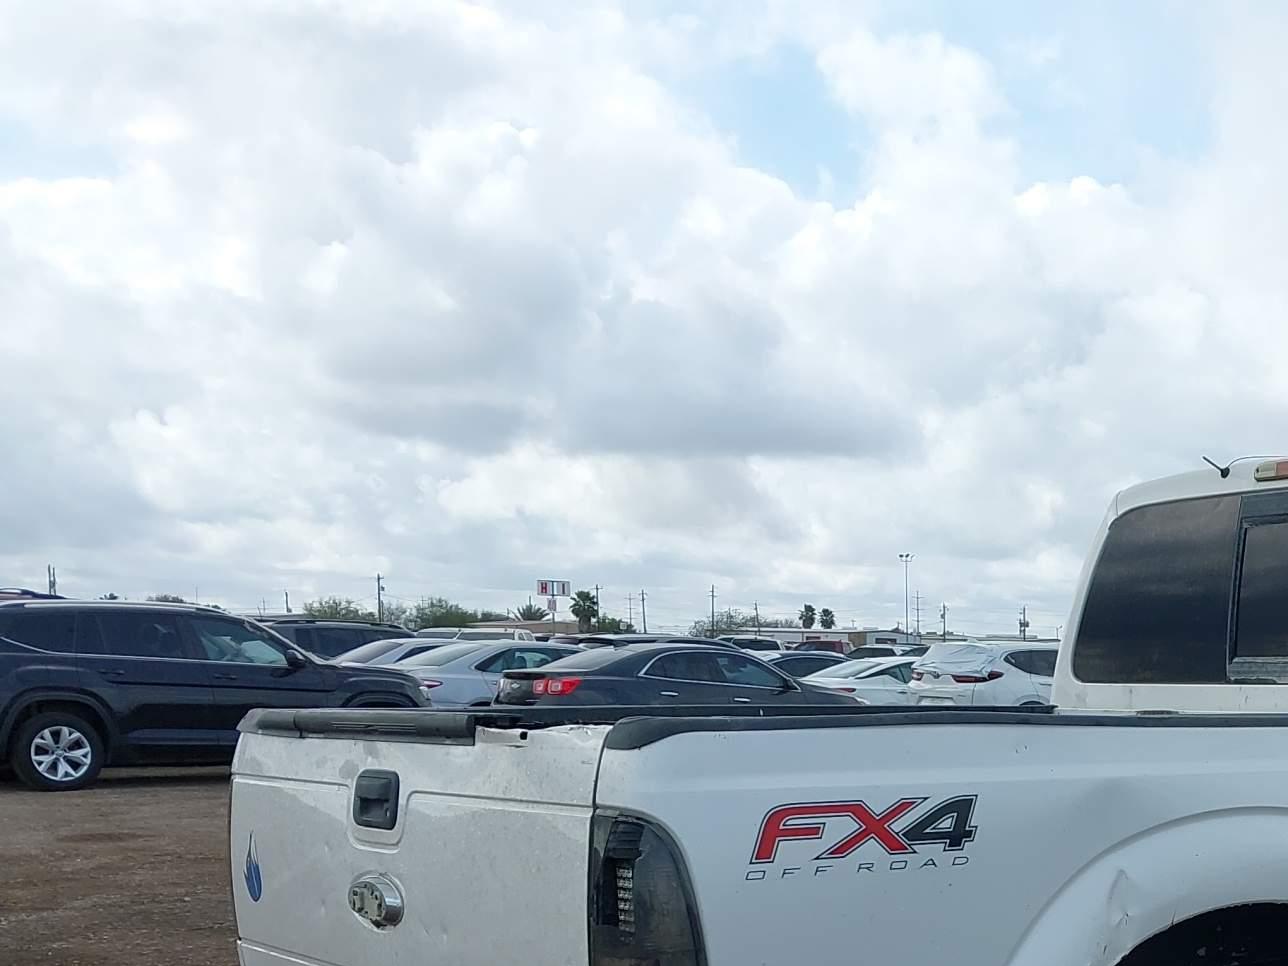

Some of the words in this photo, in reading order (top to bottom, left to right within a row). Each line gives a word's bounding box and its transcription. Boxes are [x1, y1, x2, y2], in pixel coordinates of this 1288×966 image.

[749, 794, 979, 865] FX4
[745, 864, 833, 881] OFF
[856, 856, 970, 873] ROAD
